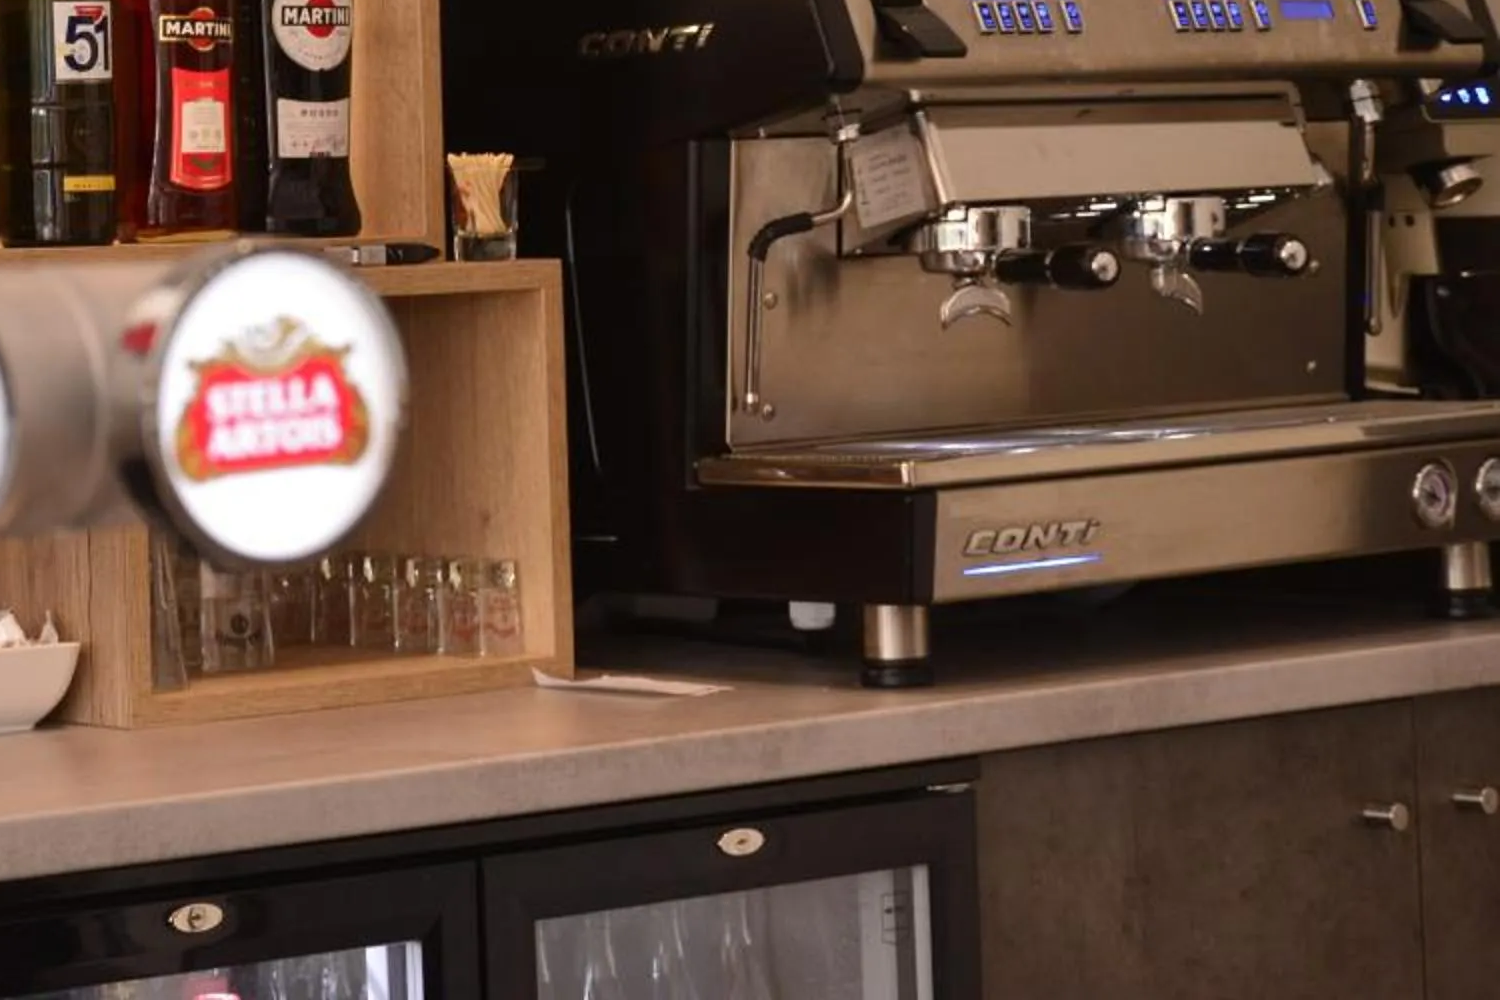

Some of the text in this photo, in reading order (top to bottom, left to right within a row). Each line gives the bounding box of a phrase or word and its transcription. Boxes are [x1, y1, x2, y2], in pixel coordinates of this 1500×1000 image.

[165, 19, 232, 38] MARTINI
[284, 7, 350, 26] MARTINI
[64, 14, 110, 74] 51
[204, 371, 341, 421] STELLA
[205, 415, 343, 464] ARTOIS
